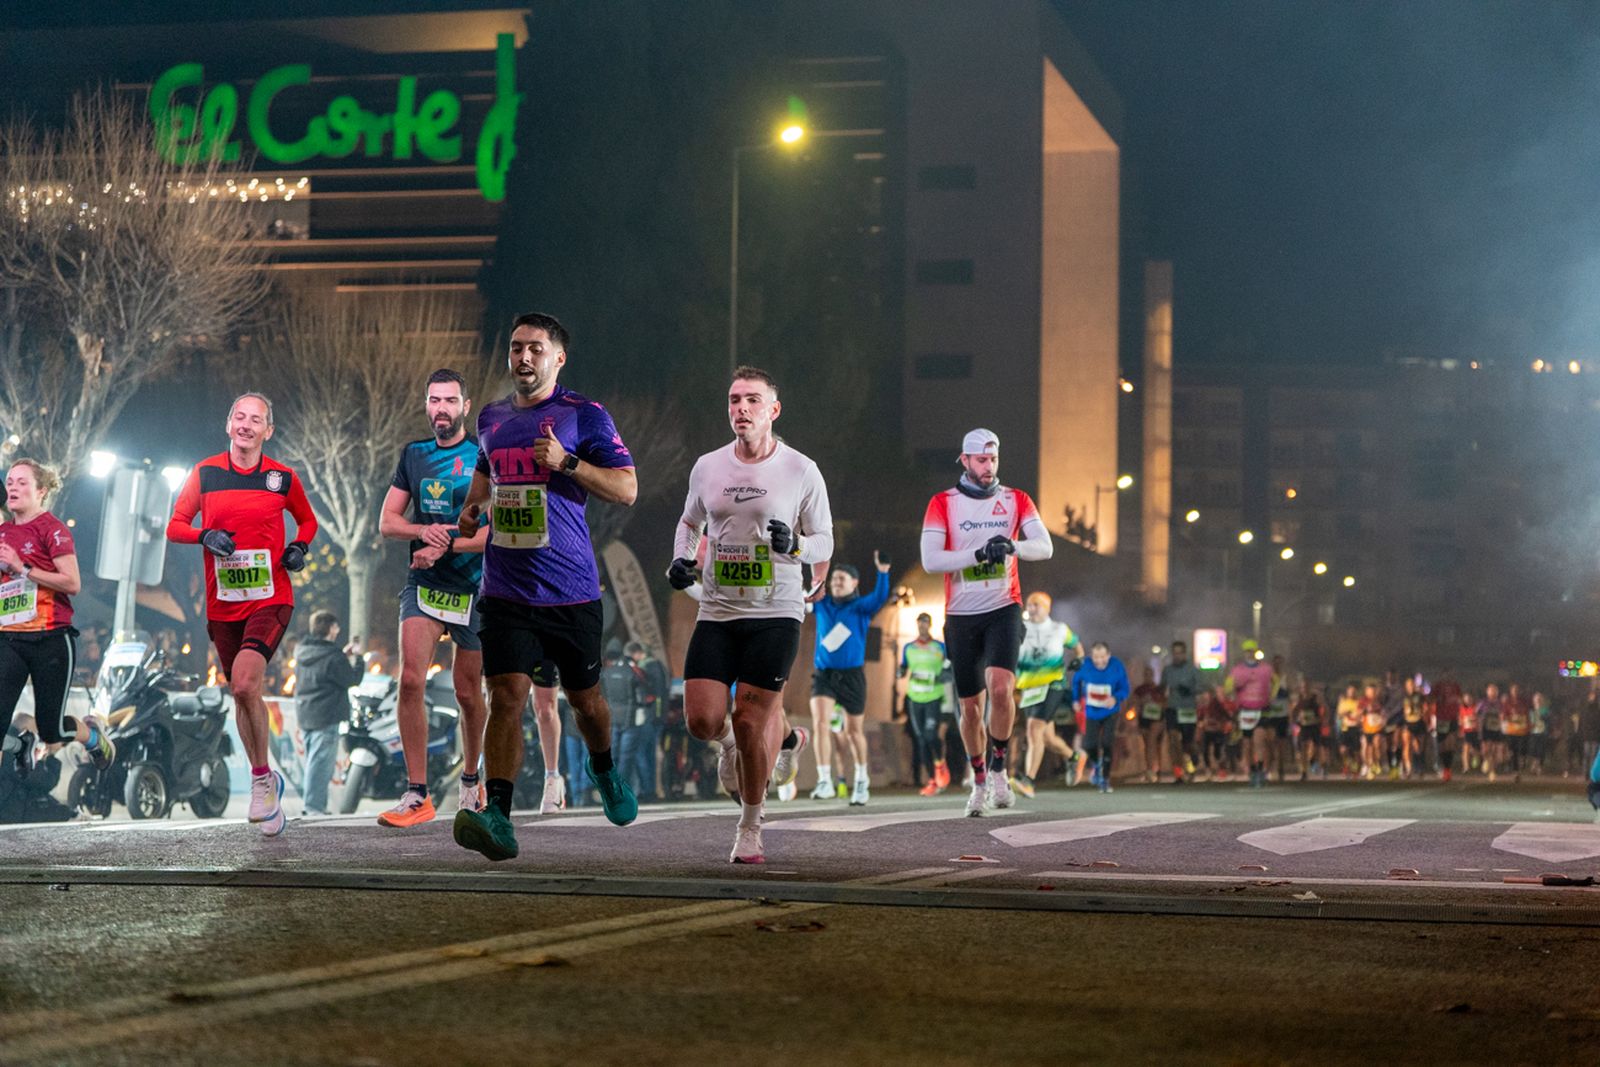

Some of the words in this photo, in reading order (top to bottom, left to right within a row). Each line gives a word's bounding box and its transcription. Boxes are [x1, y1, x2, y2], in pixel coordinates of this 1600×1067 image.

[150, 62, 241, 165] El
[247, 63, 462, 163] Corte
[746, 486, 768, 496] PRO
[498, 508, 533, 527] 2415
[227, 567, 260, 584] 3017
[721, 562, 763, 580] 4259
[3, 593, 28, 611] 8576
[427, 589, 461, 608] 8276
